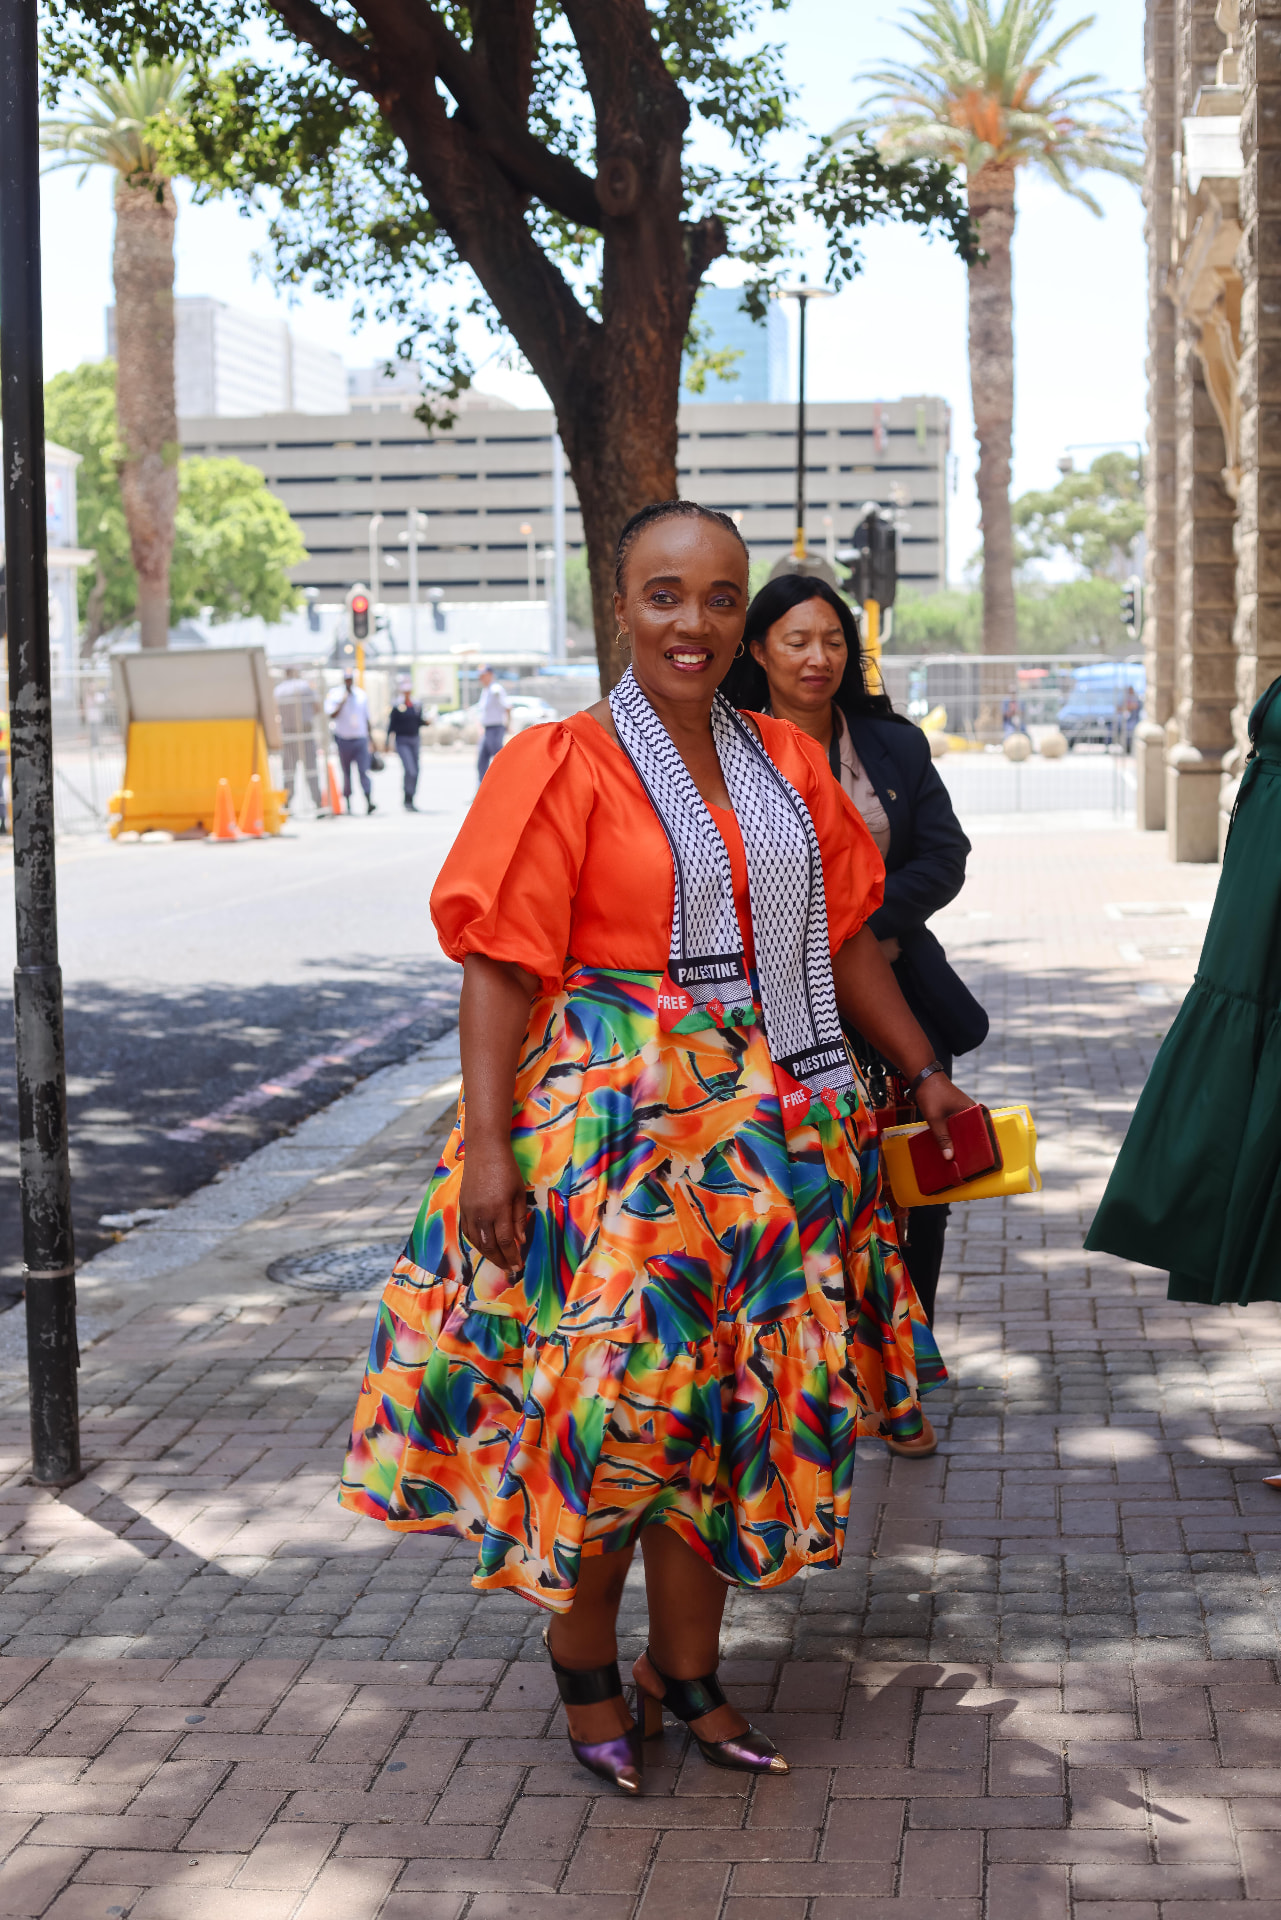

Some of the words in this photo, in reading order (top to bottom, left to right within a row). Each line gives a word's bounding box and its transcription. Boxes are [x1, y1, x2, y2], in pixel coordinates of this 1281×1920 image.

[678, 962, 739, 983] PALESTINE
[657, 994, 688, 1010] FREE
[782, 1088, 808, 1109] FREE
